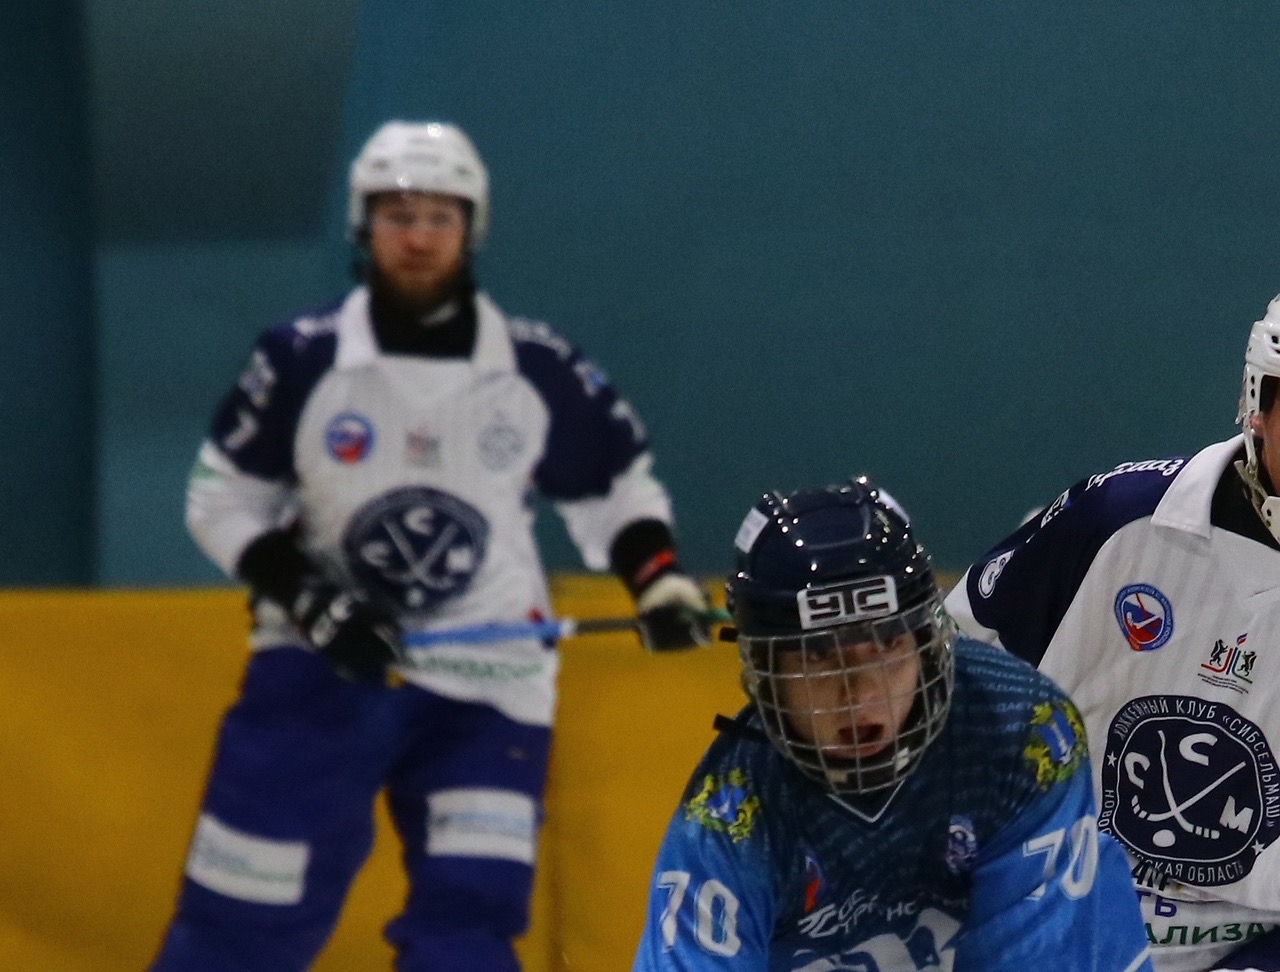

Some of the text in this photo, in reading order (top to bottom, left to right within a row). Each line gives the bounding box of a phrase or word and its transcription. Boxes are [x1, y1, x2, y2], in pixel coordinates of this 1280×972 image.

[1113, 697, 1280, 828] ХОККЕЙНЫЙ КЛУБ «СИБСЕЛЬМАШ»
[1022, 814, 1099, 901] 70
[1187, 861, 1244, 884] ОБЛАСТЬ
[656, 871, 741, 958] 70
